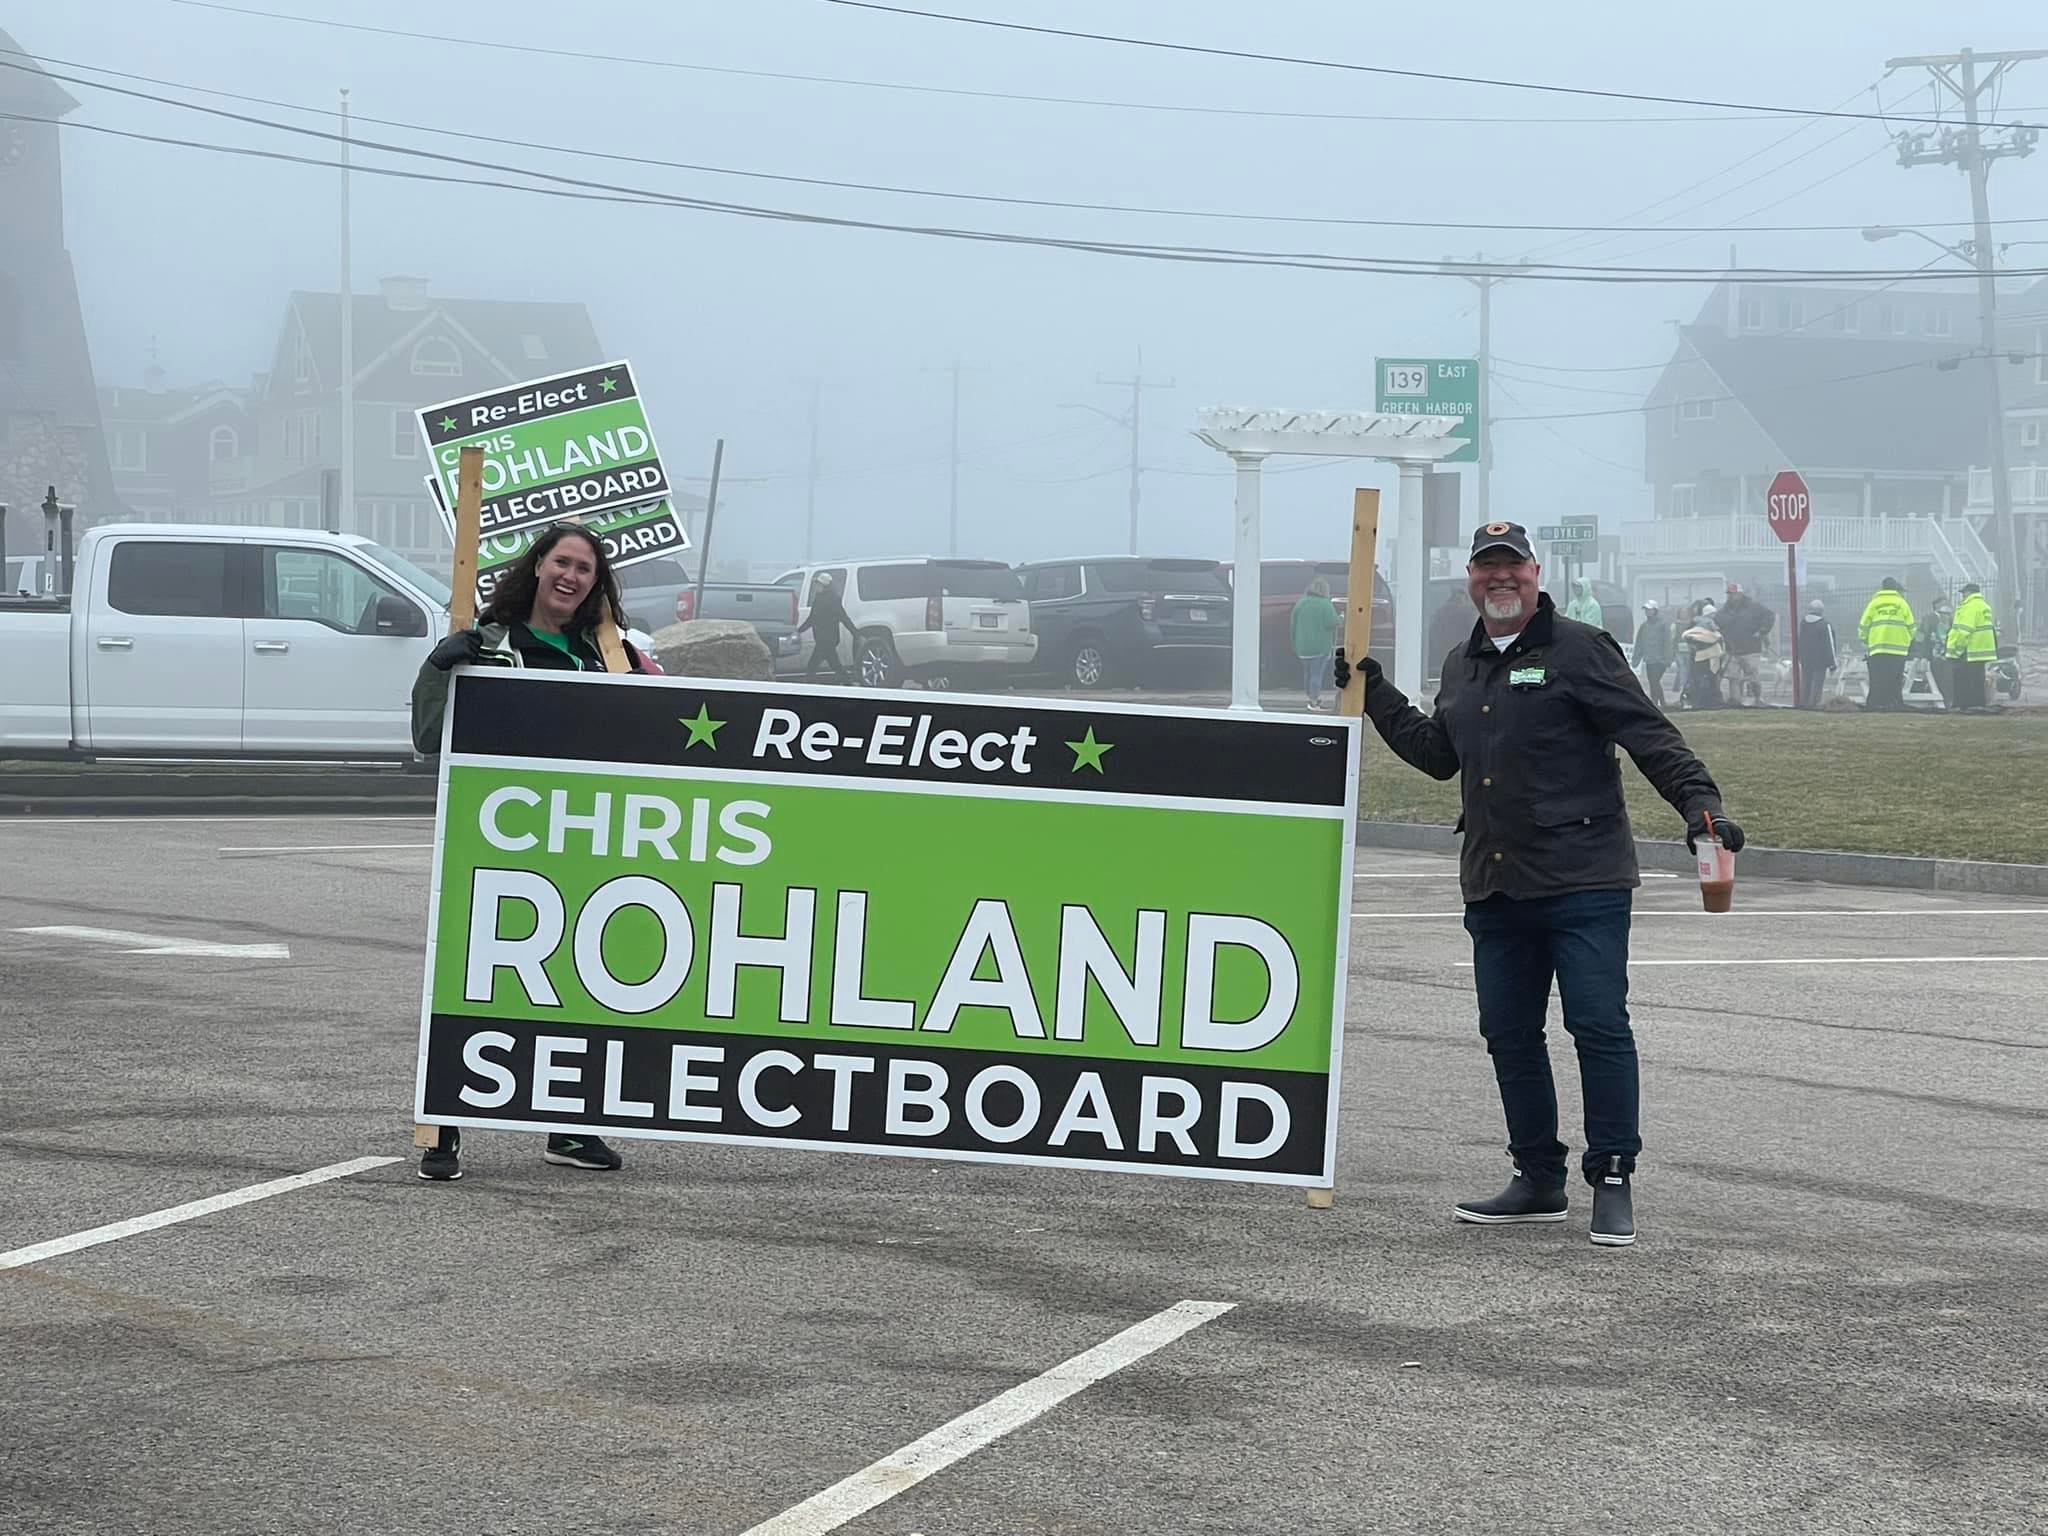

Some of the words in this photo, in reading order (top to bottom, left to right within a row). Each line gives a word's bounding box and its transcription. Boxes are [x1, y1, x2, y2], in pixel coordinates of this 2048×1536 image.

[1389, 371, 1423, 389] 139
[1438, 364, 1468, 378] EAST
[471, 382, 588, 427] Re-Elect
[1382, 402, 1421, 414] GREEN
[1426, 402, 1473, 415] HARBOR
[441, 434, 516, 466] CRIS
[479, 466, 662, 528] ELECTBOARD
[1770, 494, 1807, 521] STOP
[752, 707, 1038, 775] Re-Elect
[478, 786, 773, 866] CHRIS
[463, 866, 1300, 1053] ROHLAND
[459, 1030, 1292, 1161] SELECTBOARD
